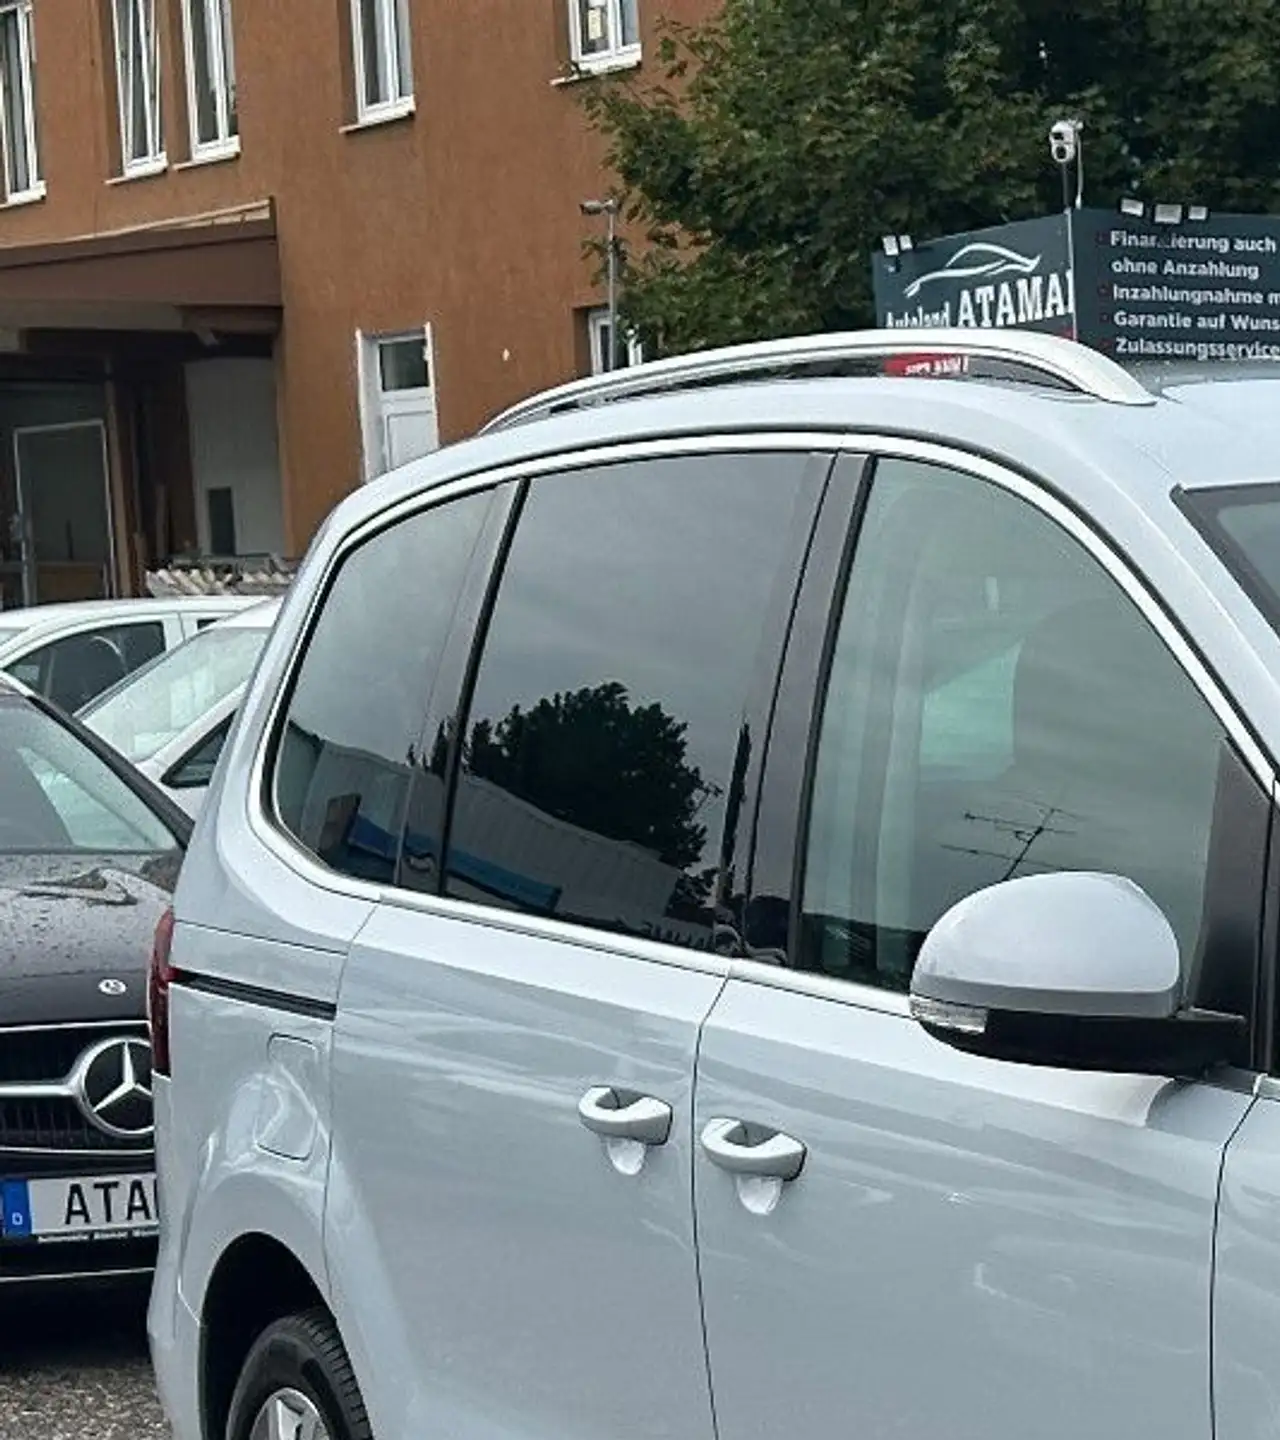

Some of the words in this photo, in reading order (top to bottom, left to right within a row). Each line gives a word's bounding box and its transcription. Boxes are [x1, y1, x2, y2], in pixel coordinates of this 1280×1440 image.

[1110, 230, 1229, 253] Finanierung
[1233, 236, 1277, 253] auch
[1111, 257, 1158, 274] ohne
[1163, 260, 1260, 280] Anzahlung
[1113, 284, 1263, 306] Inzahlungnahme
[1113, 311, 1192, 329] Garantie
[1197, 313, 1226, 330] auf
[1115, 336, 1280, 361] Zulassungsservice
